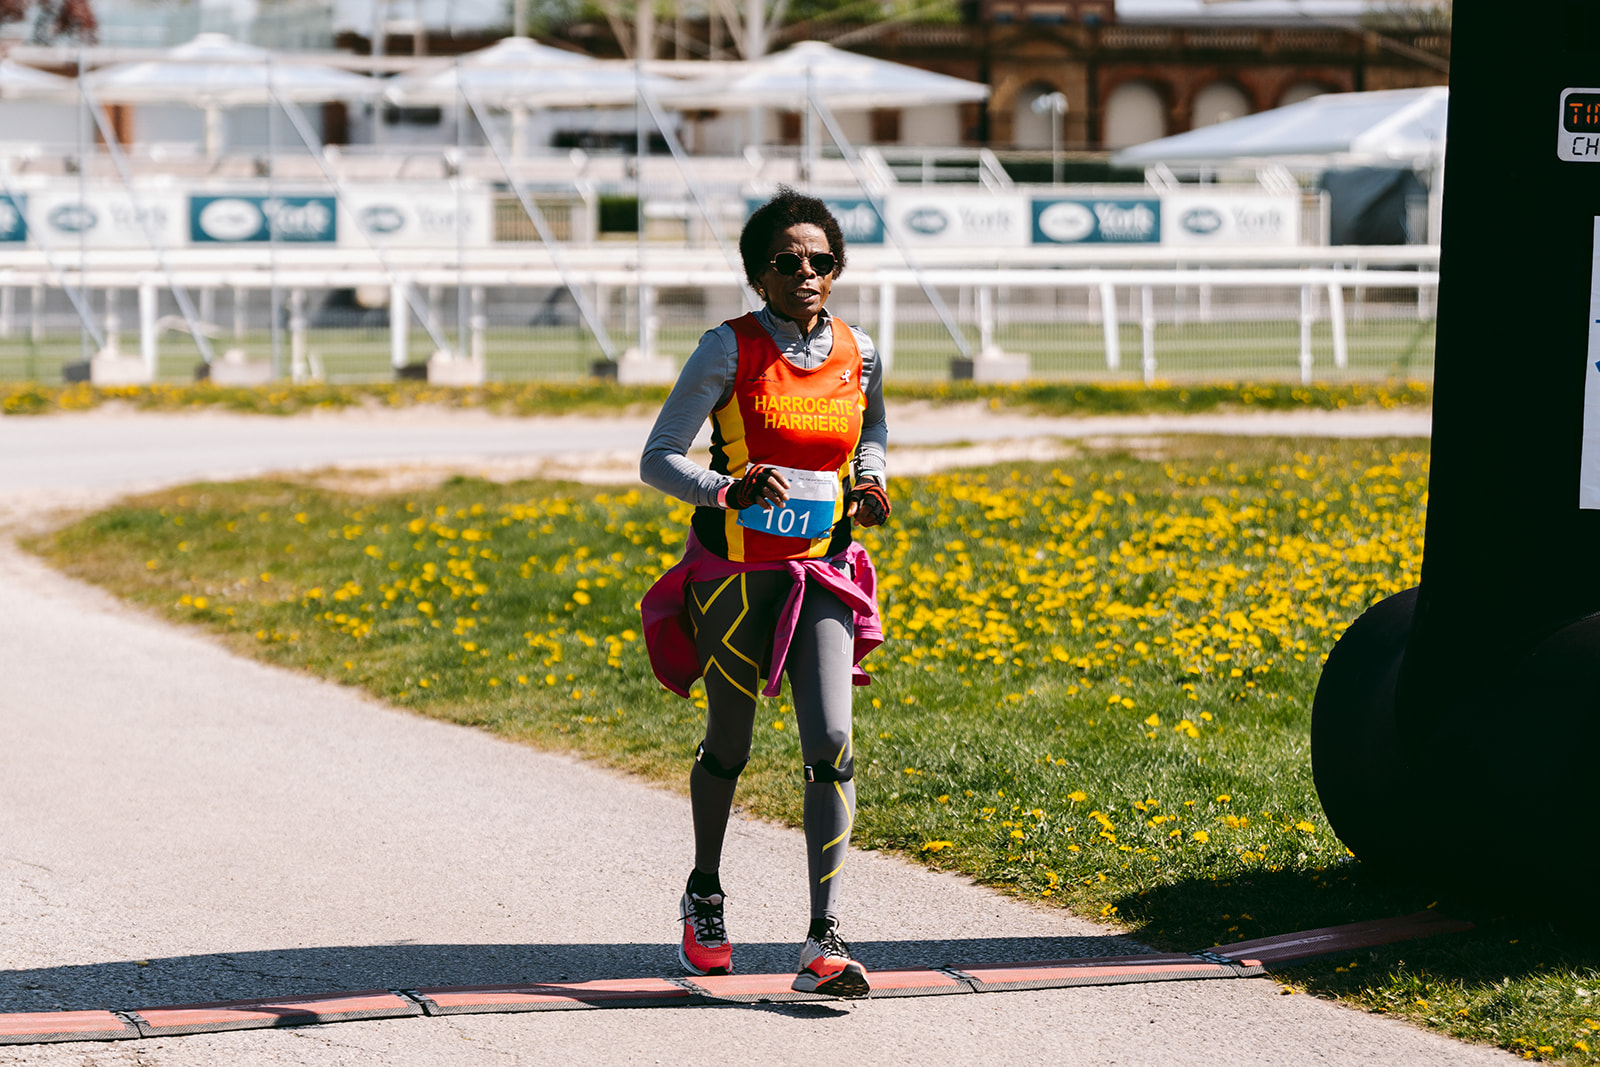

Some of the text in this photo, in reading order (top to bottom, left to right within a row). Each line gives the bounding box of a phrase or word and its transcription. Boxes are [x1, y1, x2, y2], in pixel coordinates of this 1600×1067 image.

[1093, 203, 1155, 233] York
[754, 395, 854, 416] HARROGATE
[764, 413, 849, 433] HARRIERS
[763, 506, 811, 535] 101
